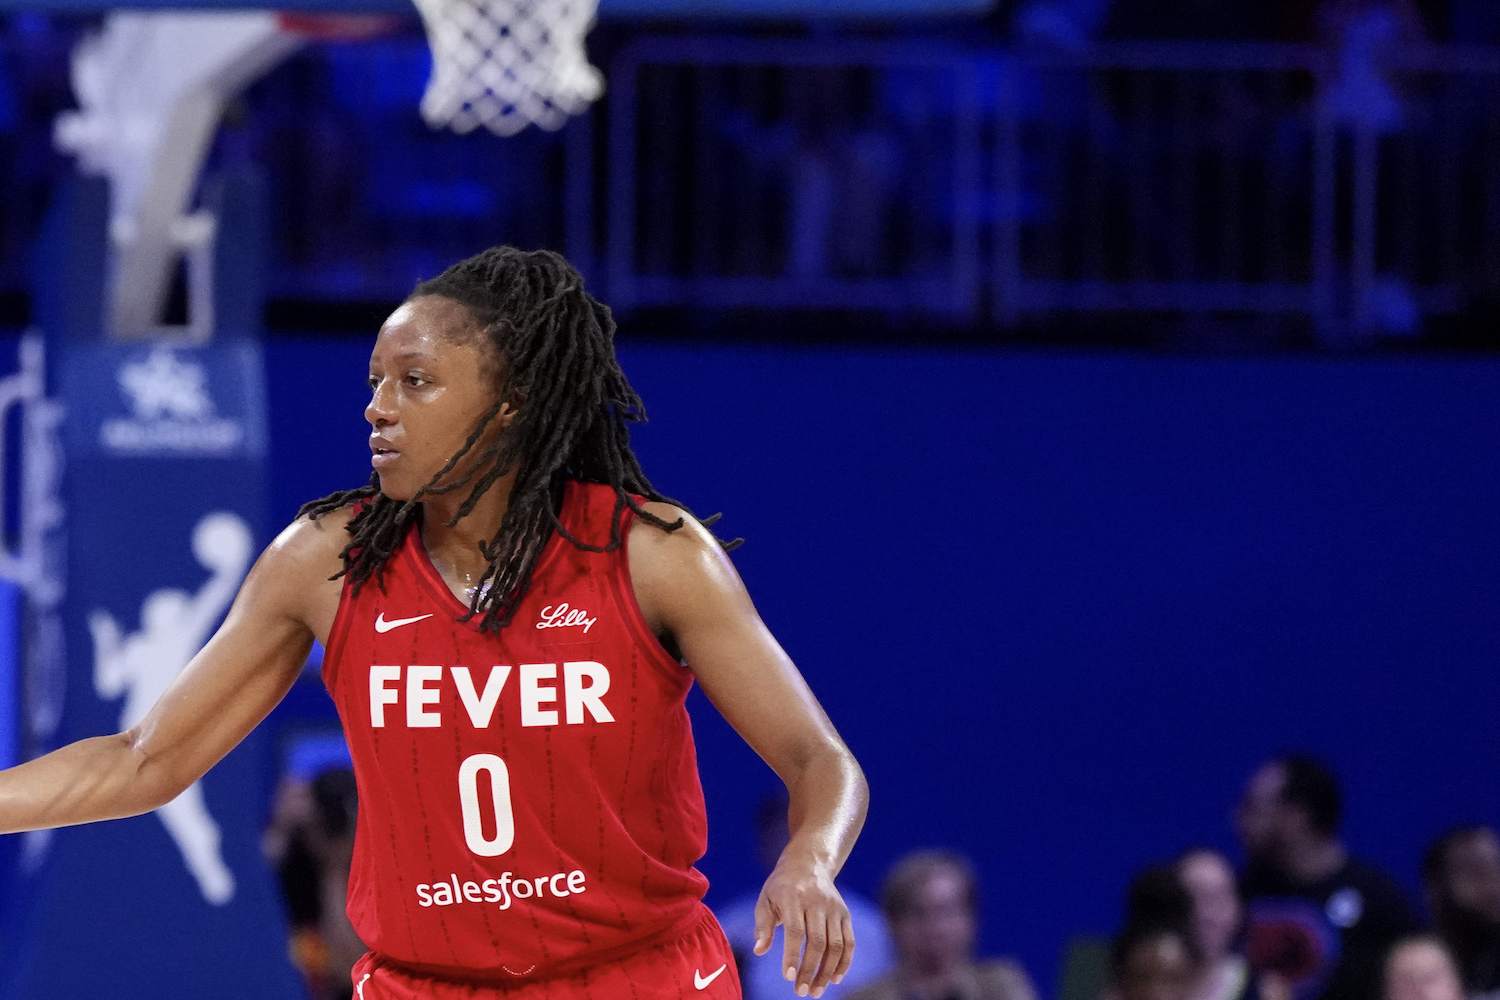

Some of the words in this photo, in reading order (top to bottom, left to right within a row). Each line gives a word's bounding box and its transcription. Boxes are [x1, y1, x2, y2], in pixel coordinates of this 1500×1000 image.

[536, 603, 597, 634] Lilly
[369, 661, 616, 729] FEVER
[459, 754, 515, 857] 0
[416, 870, 586, 910] salesforce
